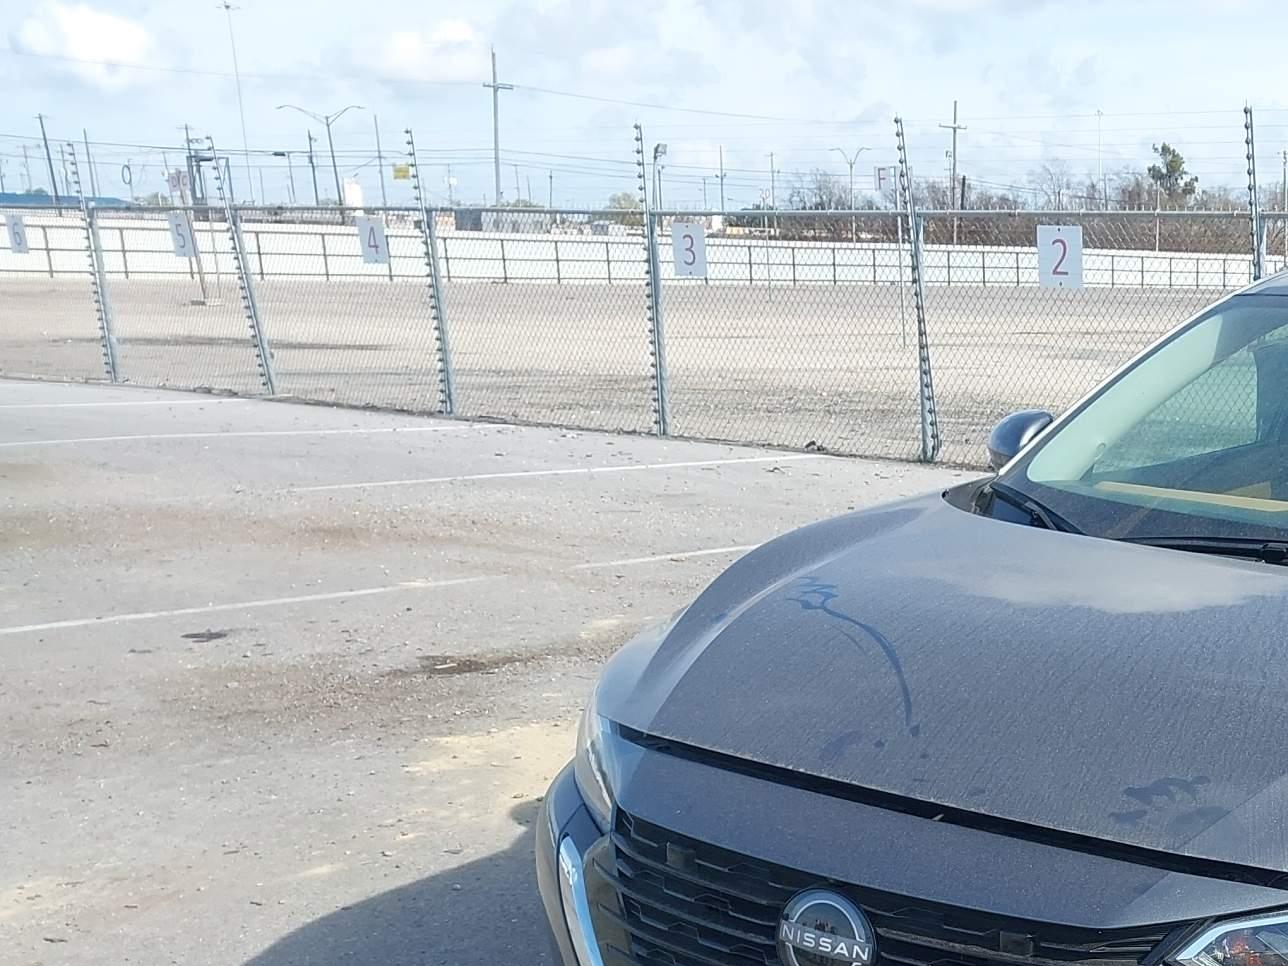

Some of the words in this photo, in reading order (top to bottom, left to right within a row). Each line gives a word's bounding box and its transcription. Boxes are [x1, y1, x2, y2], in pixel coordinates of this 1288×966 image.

[12, 221, 22, 246] 6
[175, 223, 186, 249] 5
[367, 226, 379, 255] 4
[682, 234, 696, 266] 3
[1051, 238, 1069, 276] 2
[782, 923, 869, 961] NISSAN
